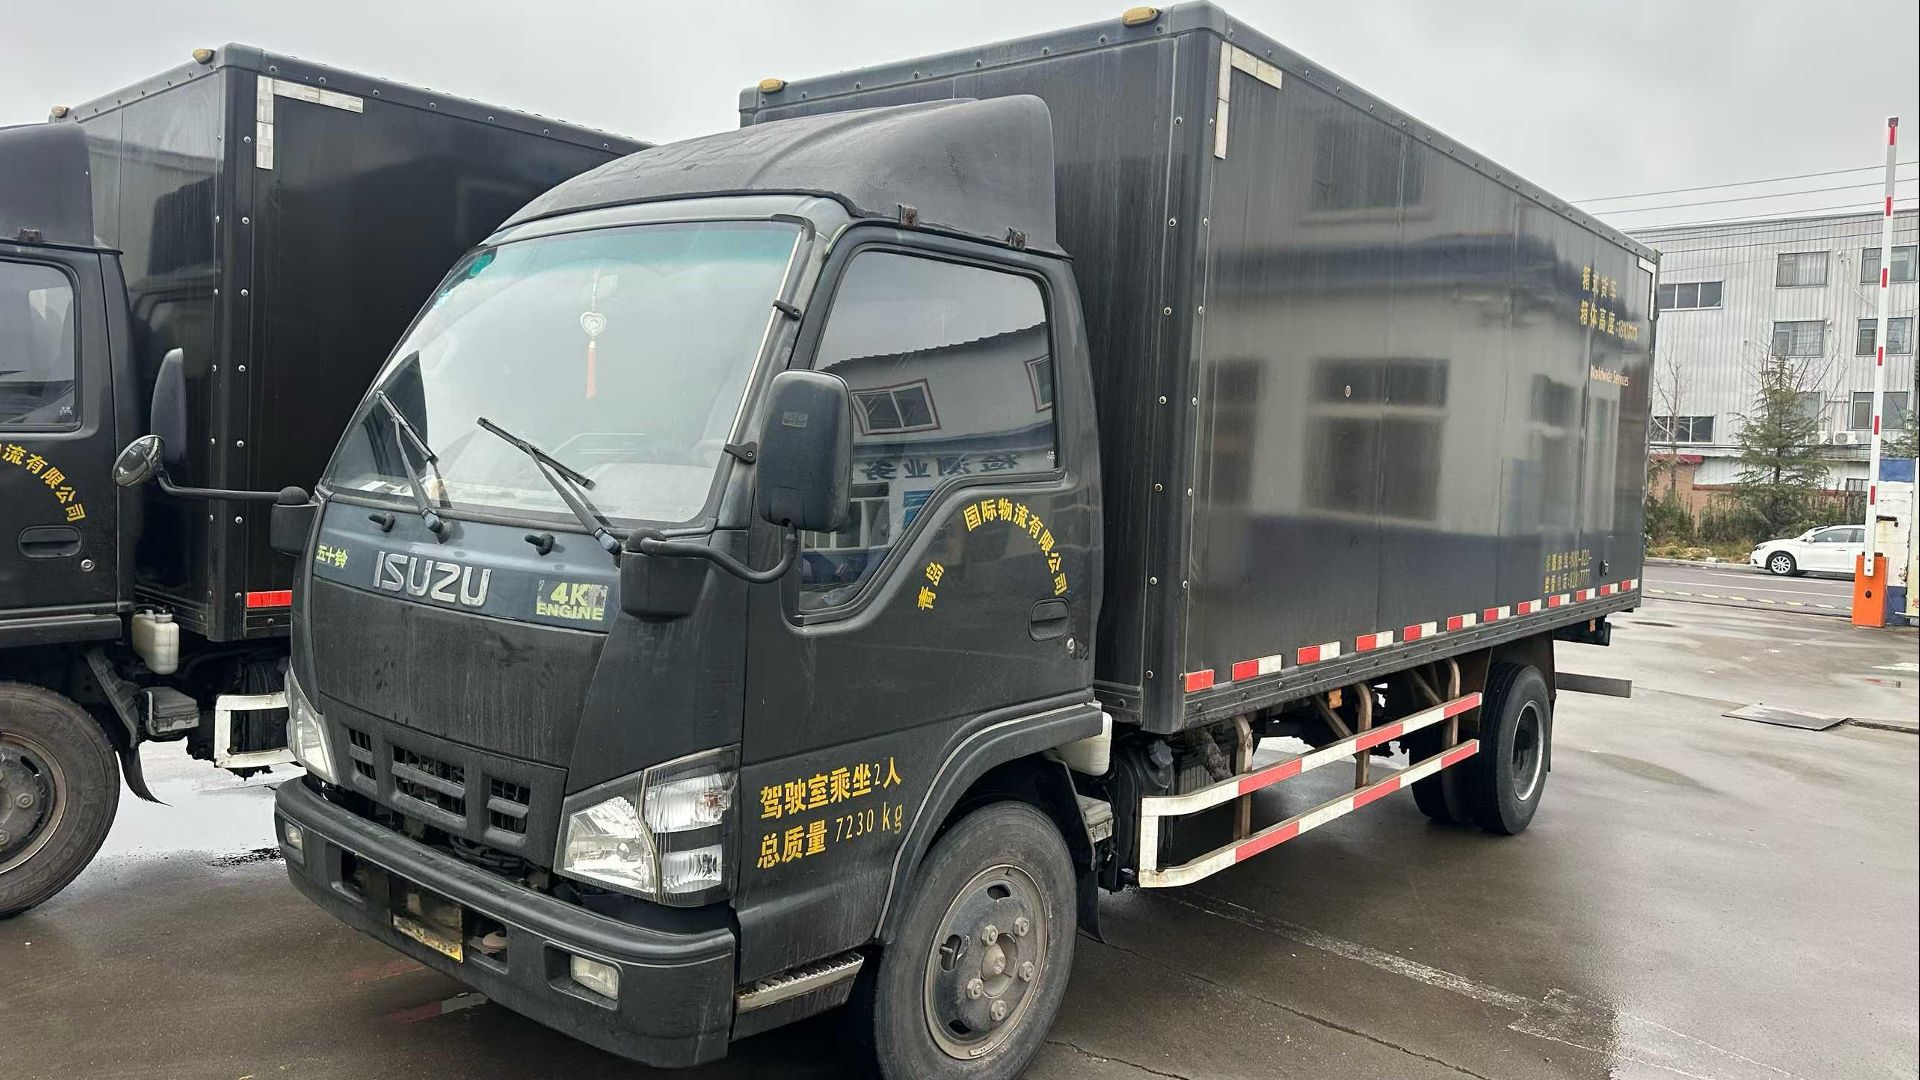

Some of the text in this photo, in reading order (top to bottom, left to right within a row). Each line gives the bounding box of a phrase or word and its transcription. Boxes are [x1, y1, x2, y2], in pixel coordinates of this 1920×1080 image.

[0, 443, 86, 522] 流有限公司
[316, 544, 349, 569] 五十铃
[373, 550, 491, 607] ISUZU
[917, 497, 1068, 611] 青岛 国际物流有限公司
[536, 602, 605, 621] ENGINE
[760, 756, 902, 820] 驾驶室乘坐2人
[757, 801, 903, 869] 总质量 7230 kg
